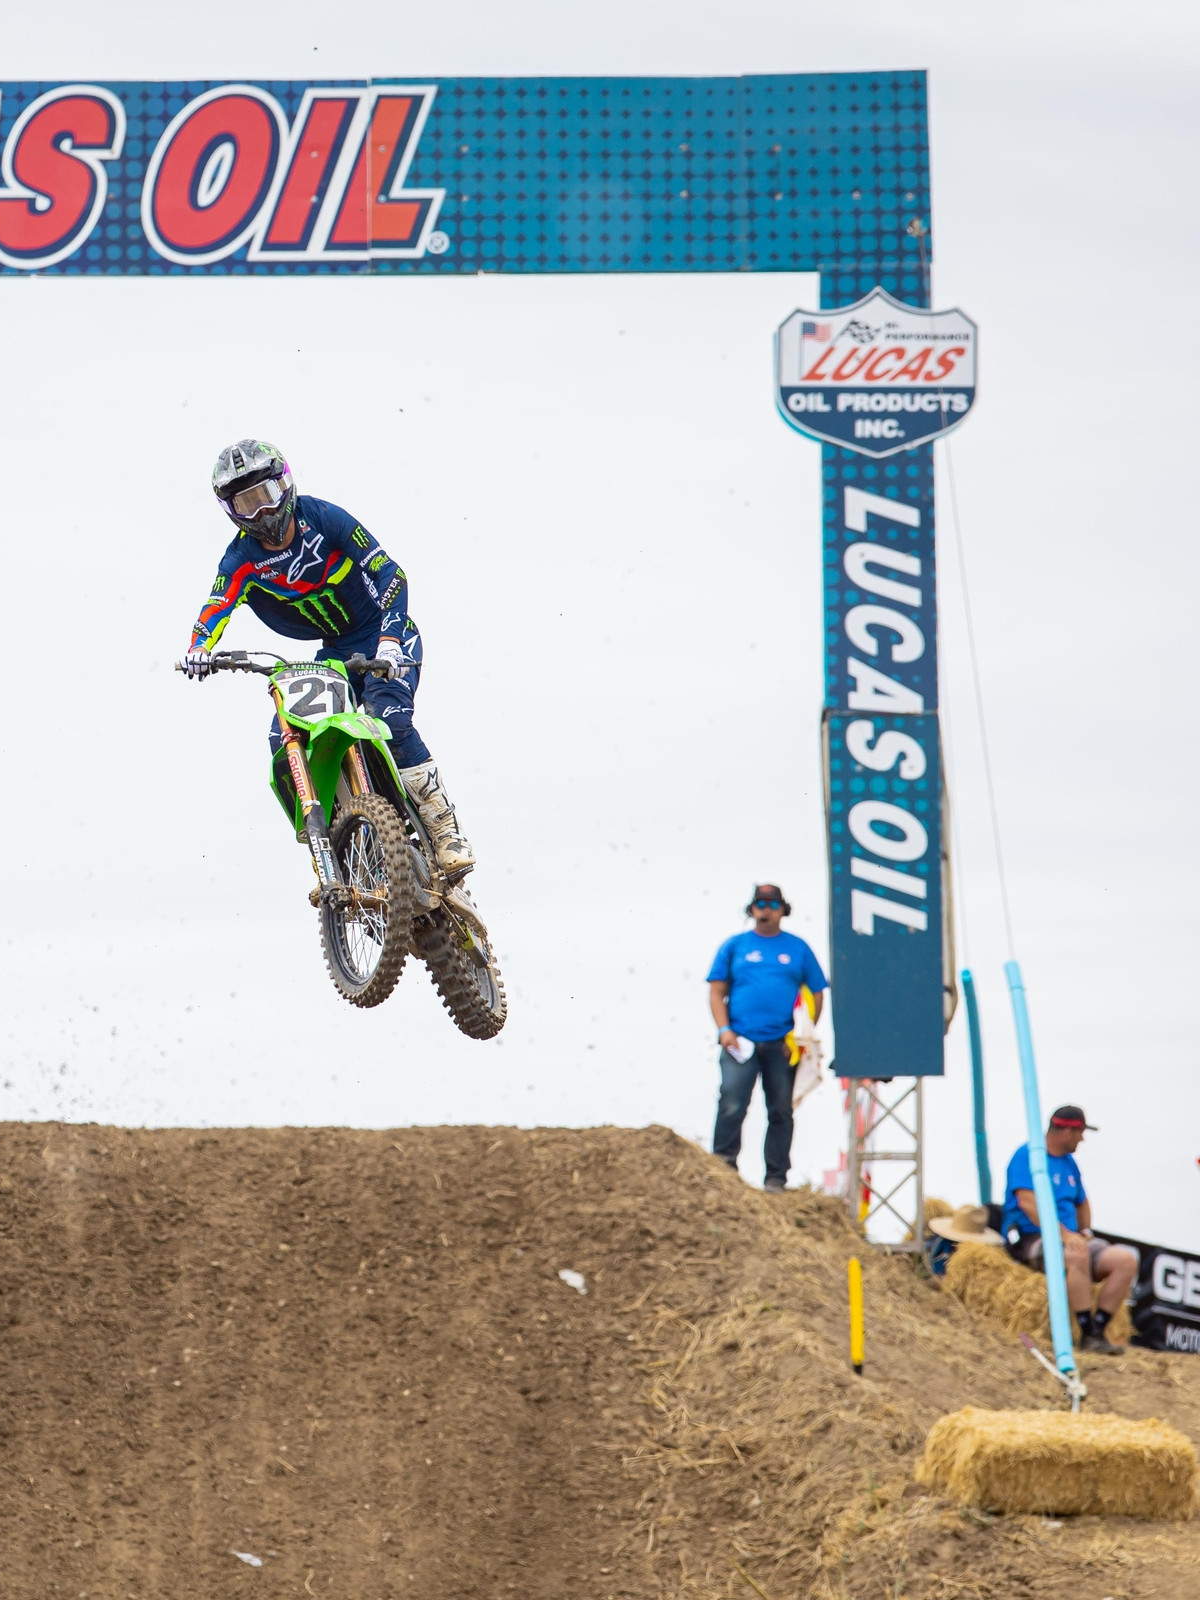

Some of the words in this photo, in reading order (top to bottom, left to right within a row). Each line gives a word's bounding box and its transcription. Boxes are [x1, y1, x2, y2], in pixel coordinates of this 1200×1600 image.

[141, 84, 446, 268] OIL
[801, 346, 967, 382] LUCAS
[787, 392, 832, 412] OIL
[836, 392, 969, 412] PRODUCTS
[854, 418, 906, 438] INC.
[843, 485, 927, 780] LUCAS
[294, 669, 317, 677] LUCAS
[288, 677, 346, 718] 21
[310, 835, 328, 886] DUNLOP
[847, 800, 929, 936] OIL
